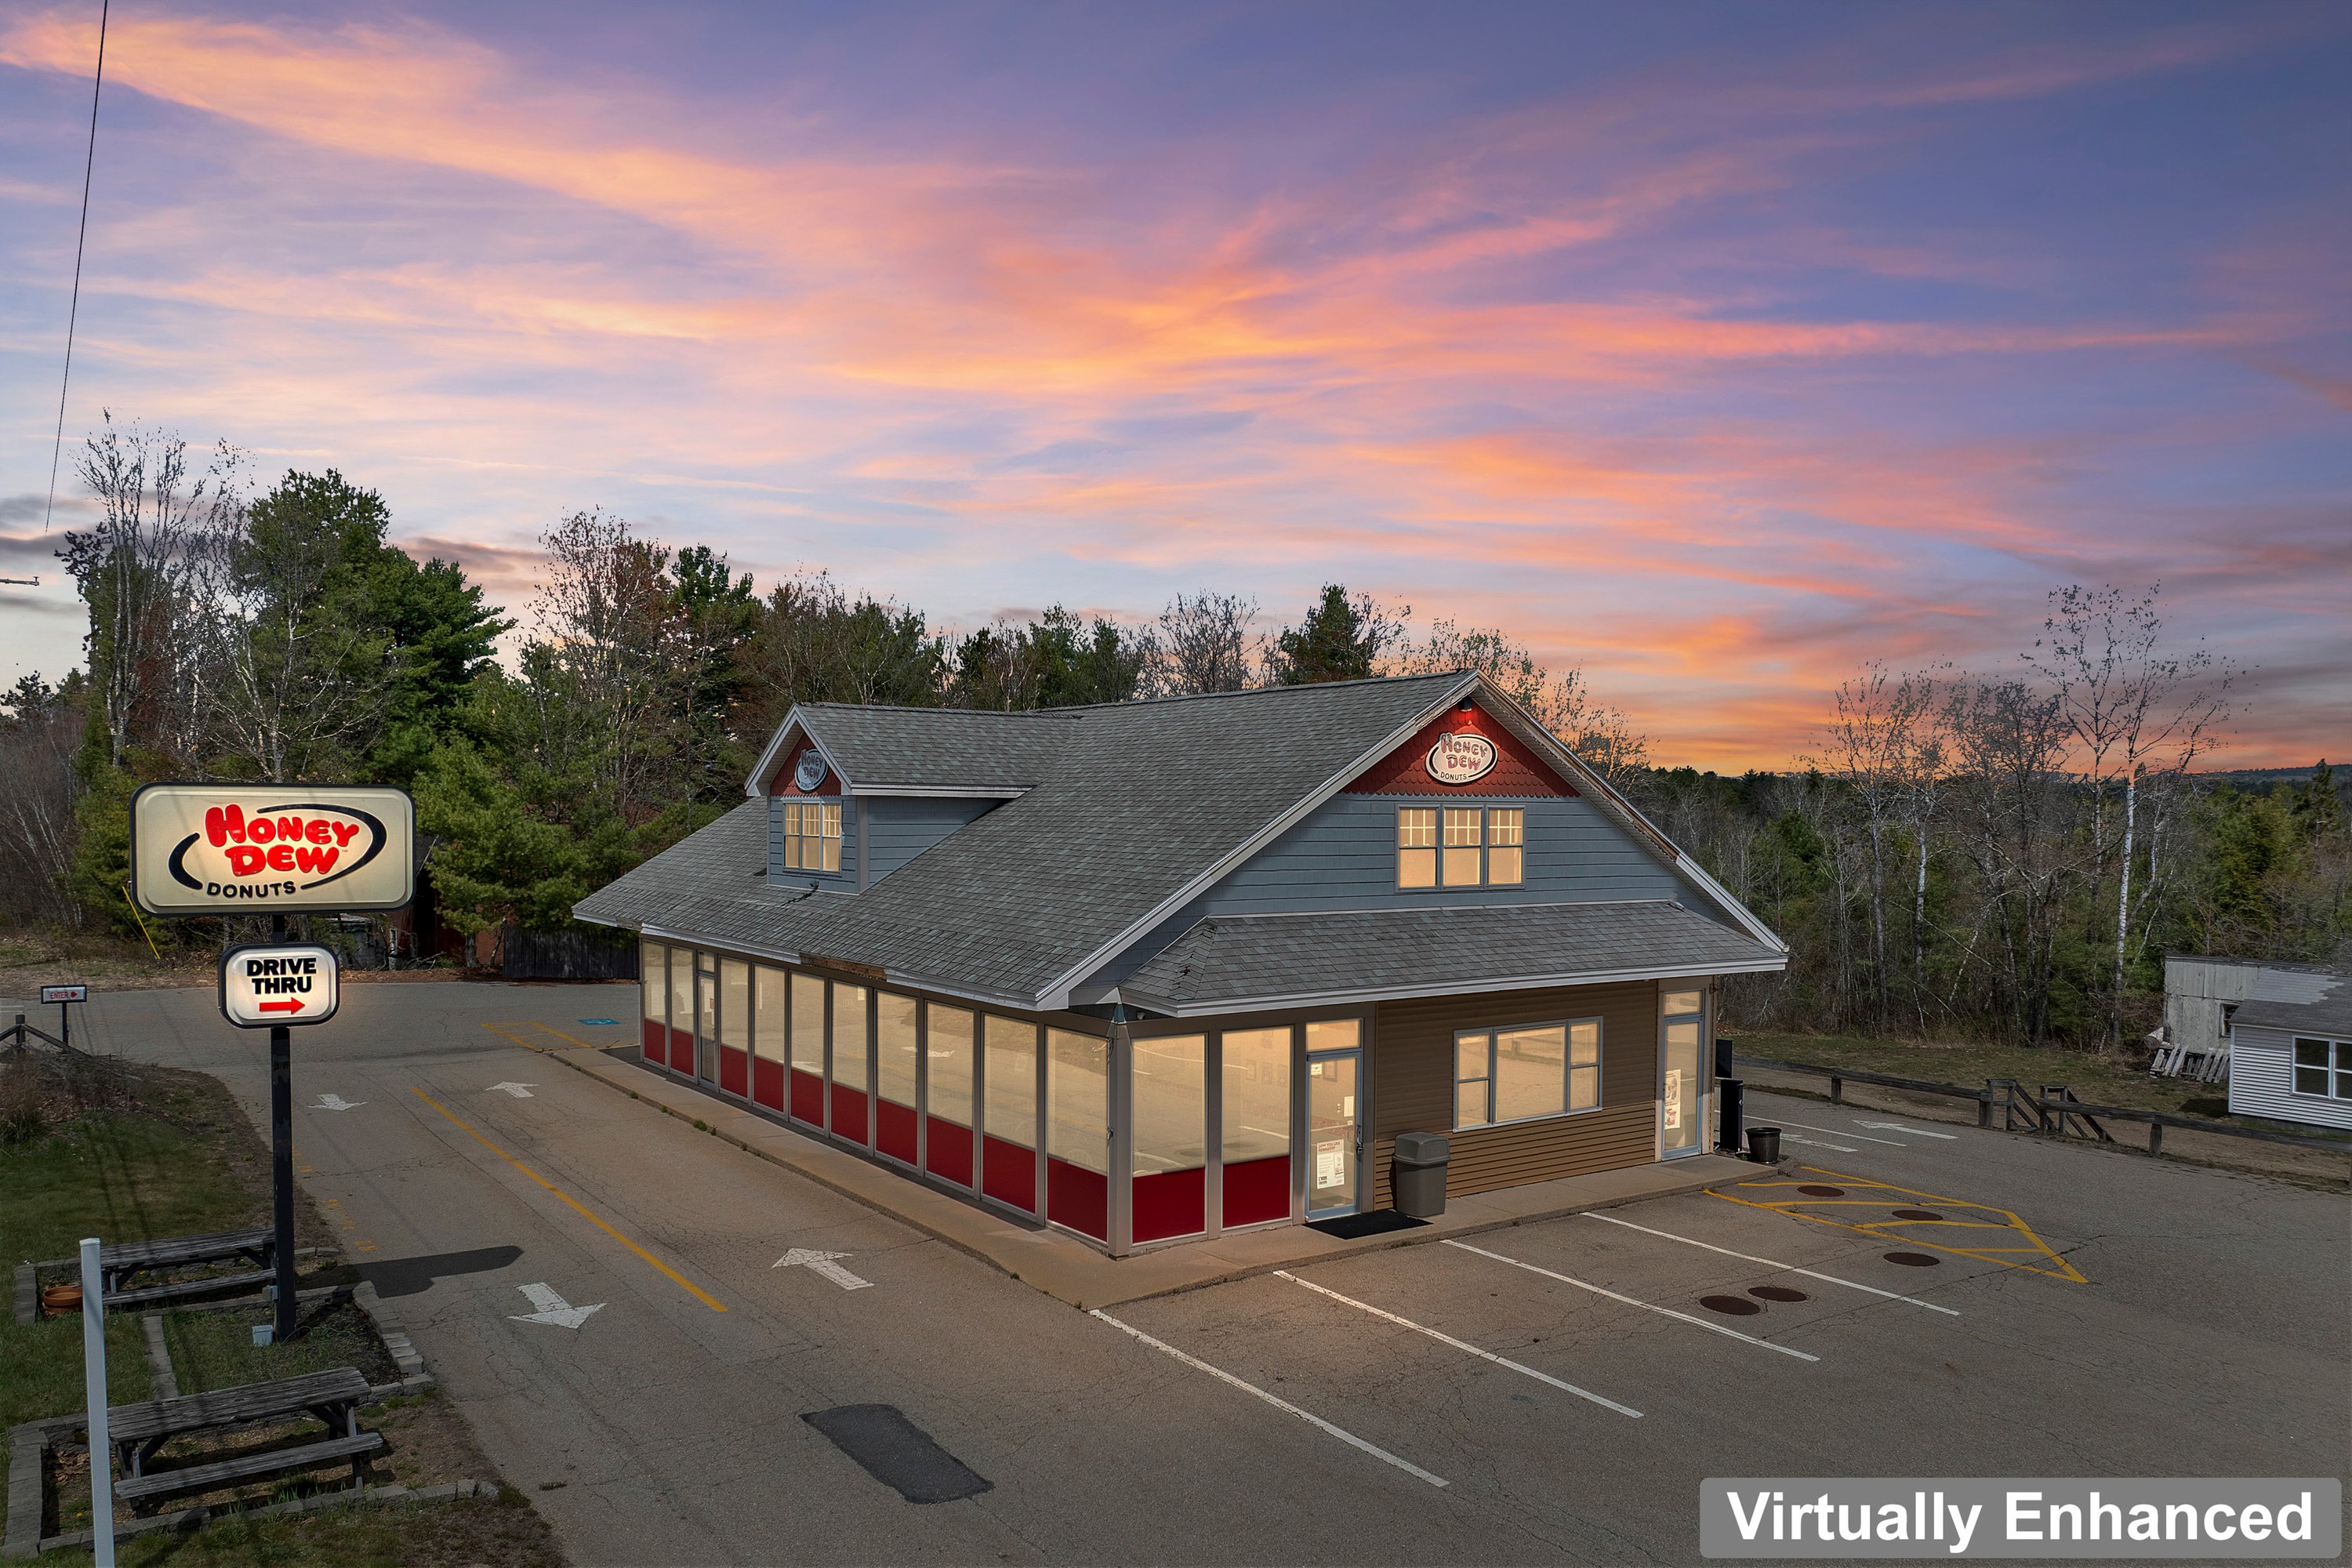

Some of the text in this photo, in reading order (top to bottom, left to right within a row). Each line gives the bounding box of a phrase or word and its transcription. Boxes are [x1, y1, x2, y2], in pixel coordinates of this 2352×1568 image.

[1440, 733, 1488, 758] HONEY
[800, 750, 824, 768] HONEY
[1446, 754, 1482, 771] DEW
[1440, 771, 1467, 781] DONUTS
[205, 804, 360, 848] HONEY
[224, 844, 340, 877] DEW
[206, 880, 296, 898] DONUTS
[246, 957, 317, 978] DRIVE
[50, 991, 68, 1000] ENTER
[251, 976, 312, 996] THRU
